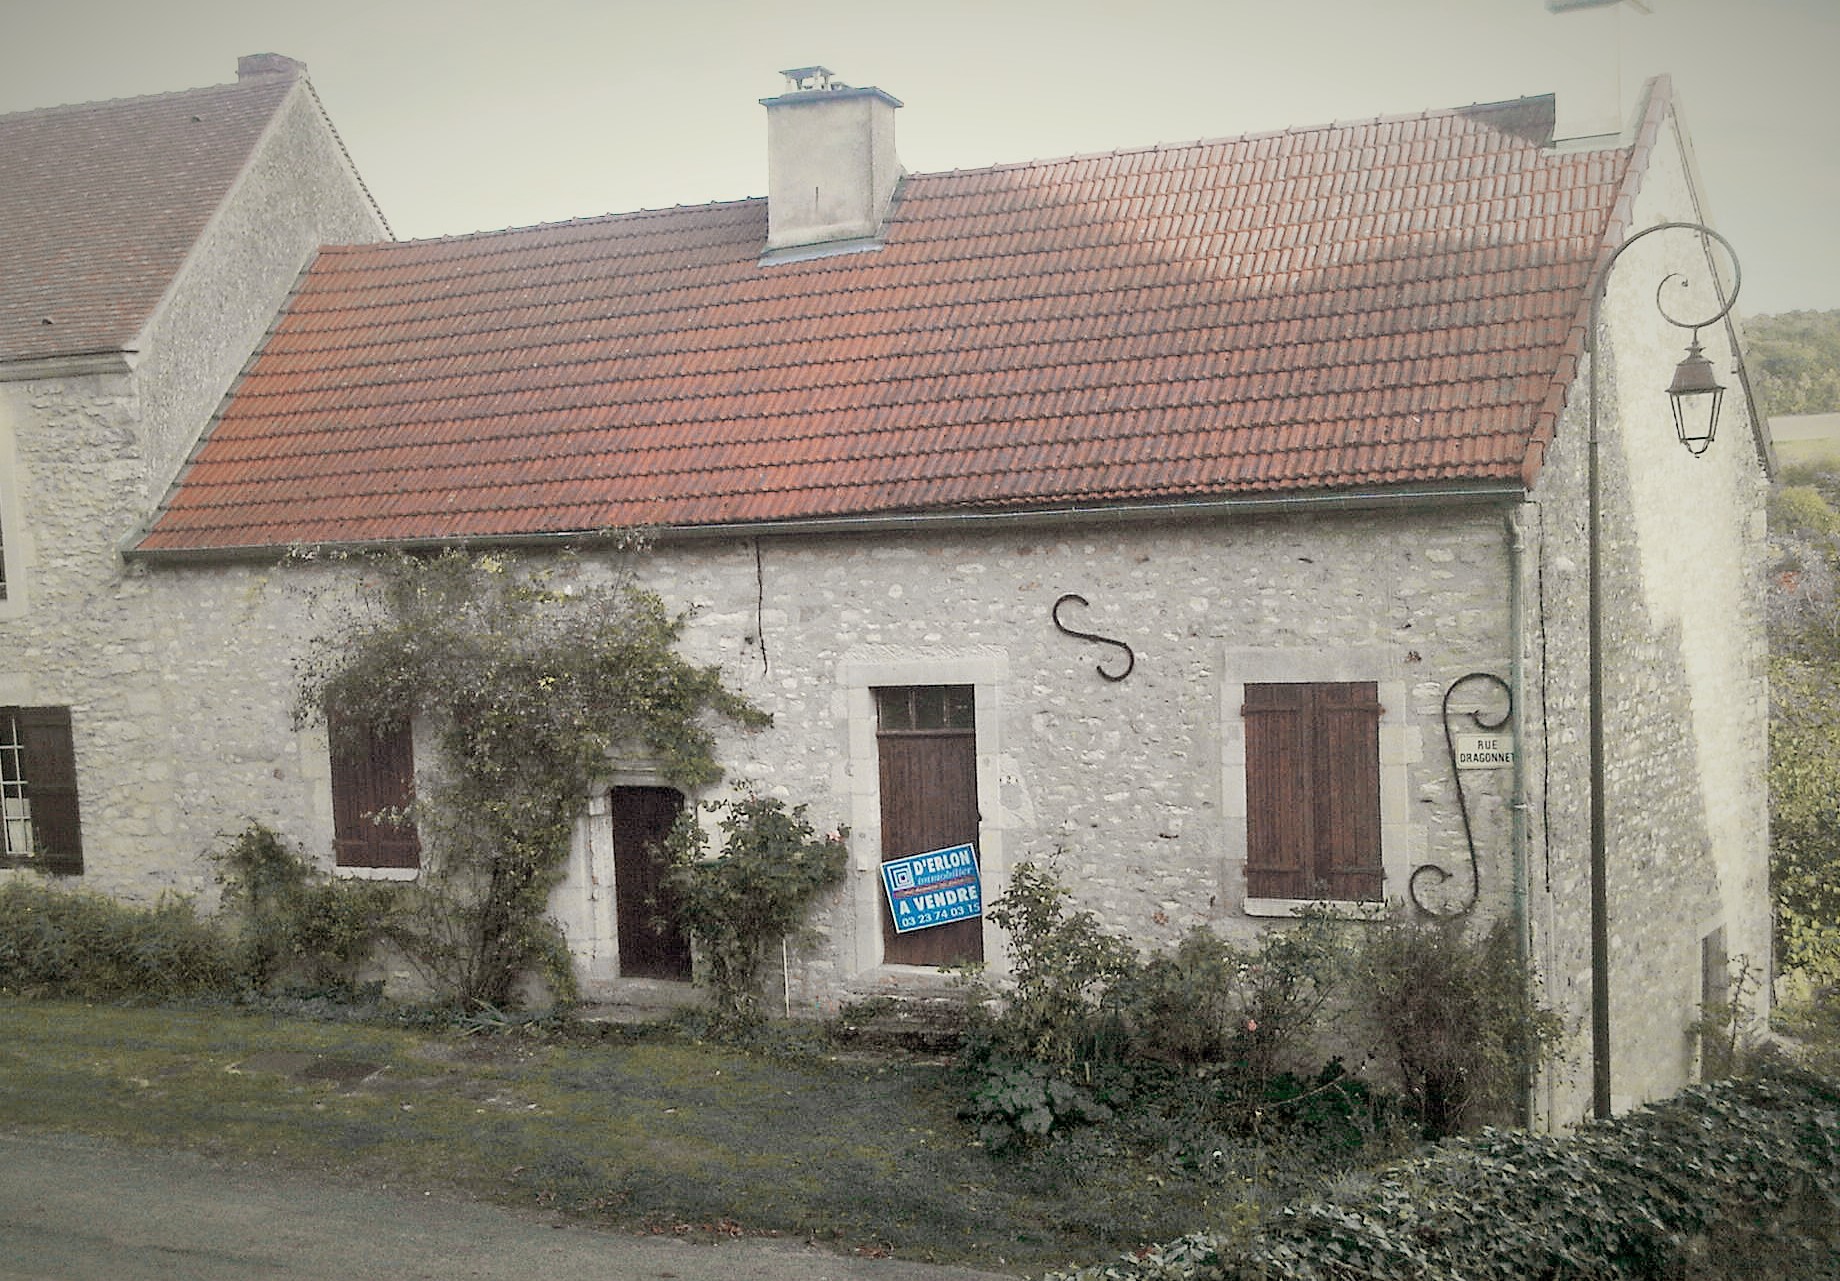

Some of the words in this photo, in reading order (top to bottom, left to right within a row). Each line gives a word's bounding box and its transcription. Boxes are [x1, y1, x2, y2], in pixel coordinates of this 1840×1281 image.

[1477, 740, 1498, 750] RUE
[913, 850, 970, 876] D'ERLON
[900, 900, 911, 915] A
[913, 885, 978, 911] VENDRE
[902, 917, 916, 927] 03
[918, 914, 932, 924] 23
[935, 909, 948, 919] 74
[951, 906, 964, 916] 03
